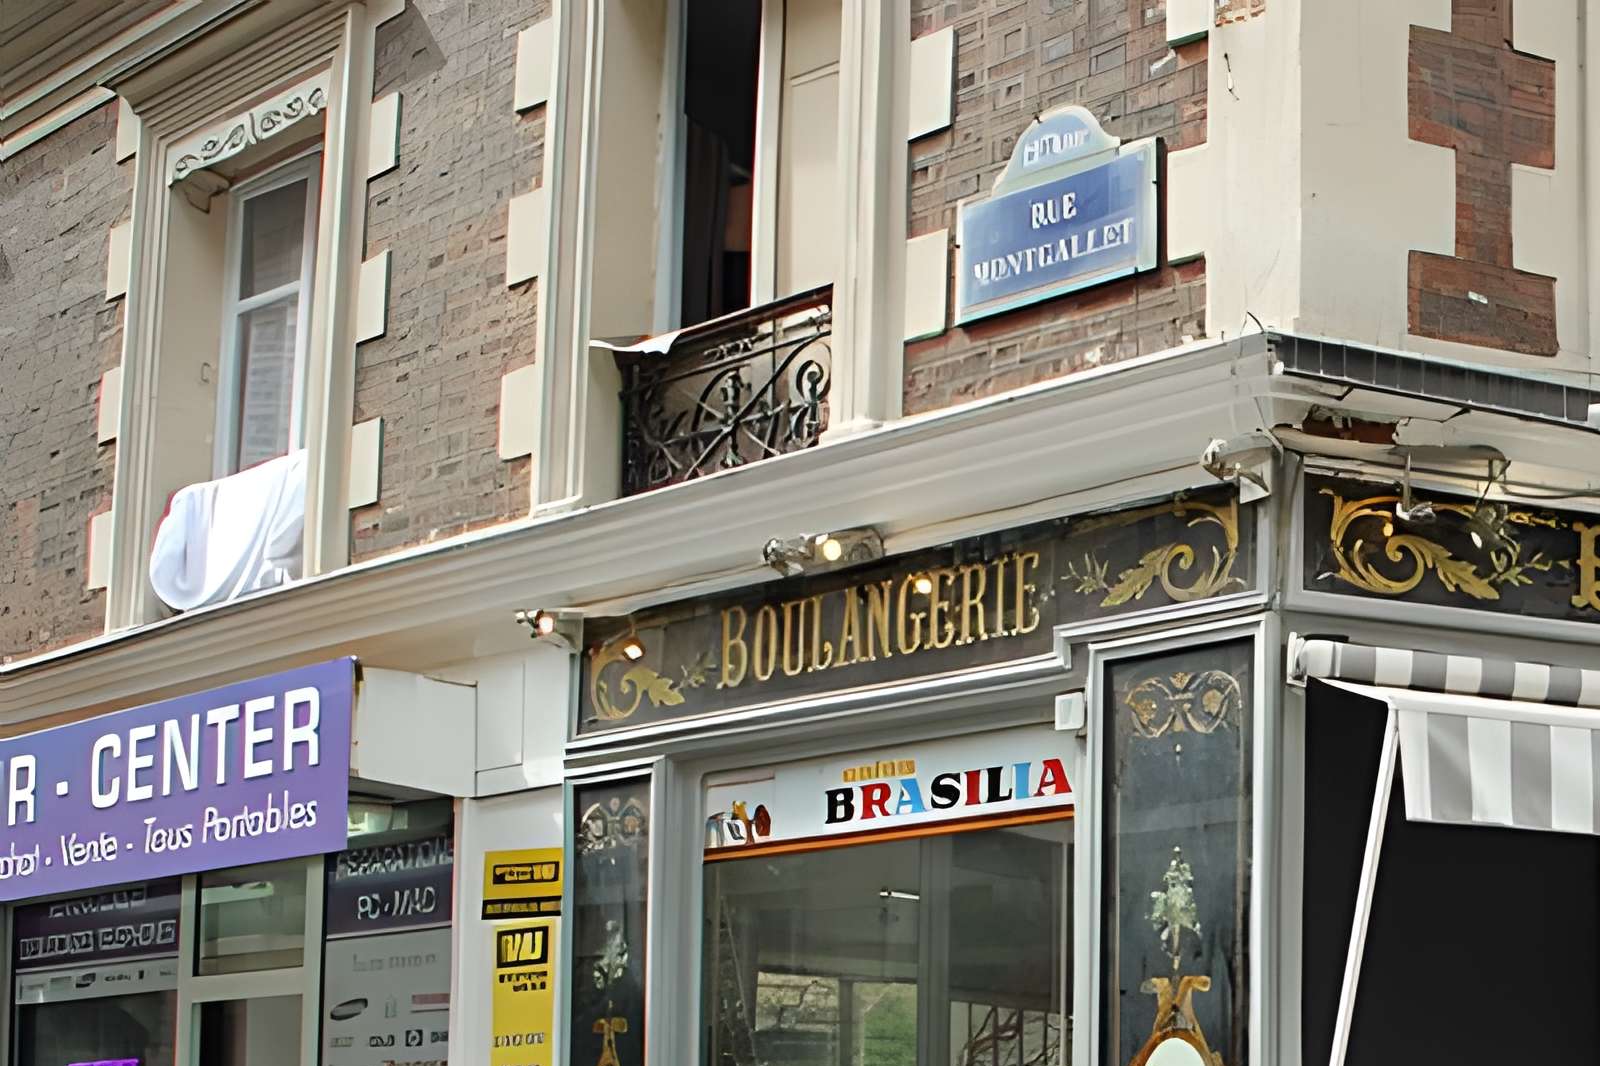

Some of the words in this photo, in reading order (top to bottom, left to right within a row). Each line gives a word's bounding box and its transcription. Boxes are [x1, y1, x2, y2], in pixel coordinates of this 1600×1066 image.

[1030, 191, 1077, 230] RUE
[717, 551, 1041, 690] BOULANGERIE
[0, 753, 38, 828] R
[90, 685, 322, 810] CENTER
[143, 816, 193, 854] Tous
[201, 789, 318, 844] Portables
[824, 758, 1073, 825] BRASILIA
